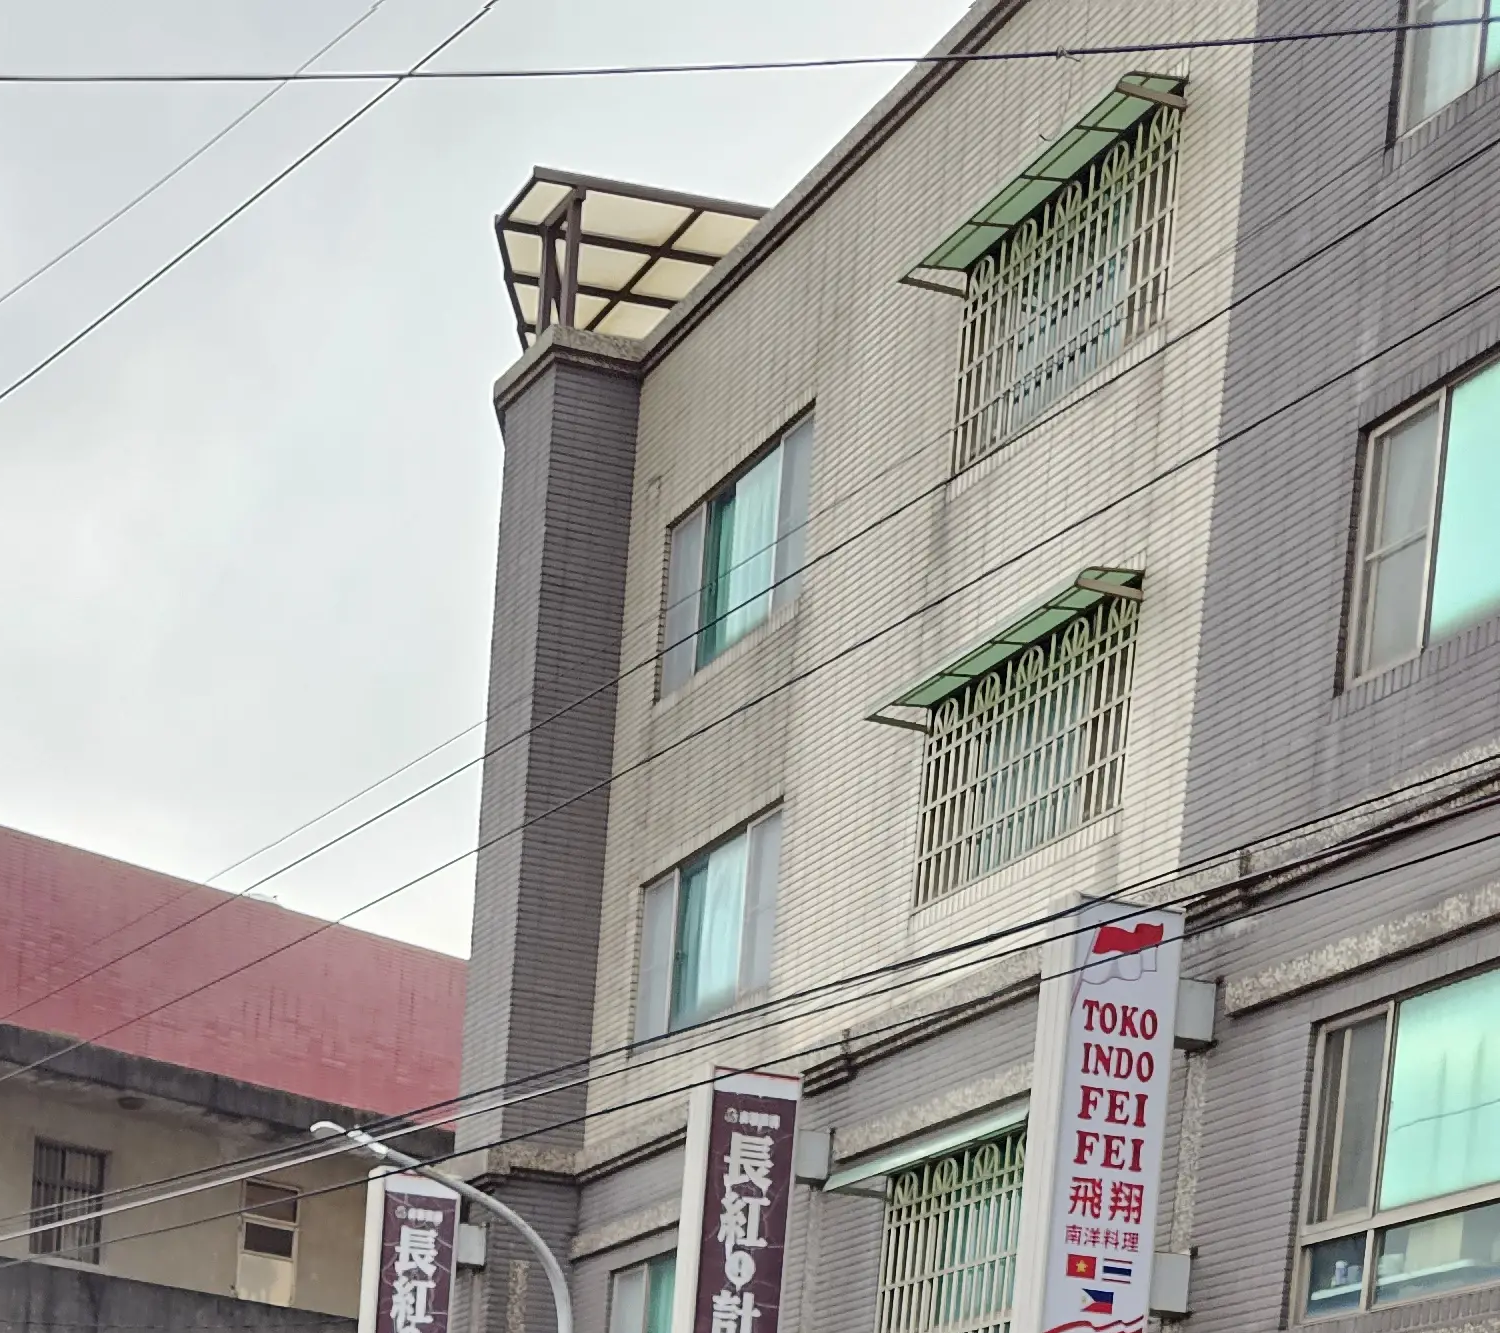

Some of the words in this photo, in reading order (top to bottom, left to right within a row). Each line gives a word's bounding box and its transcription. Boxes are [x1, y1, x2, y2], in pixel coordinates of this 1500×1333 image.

[1082, 999, 1158, 1040] TOKO
[1081, 1042, 1155, 1083] INDO
[1077, 1085, 1147, 1127] FEI
[1073, 1130, 1145, 1172] FEI
[1068, 1176, 1145, 1224] 飛翔
[1065, 1224, 1139, 1253] 南洋料理
